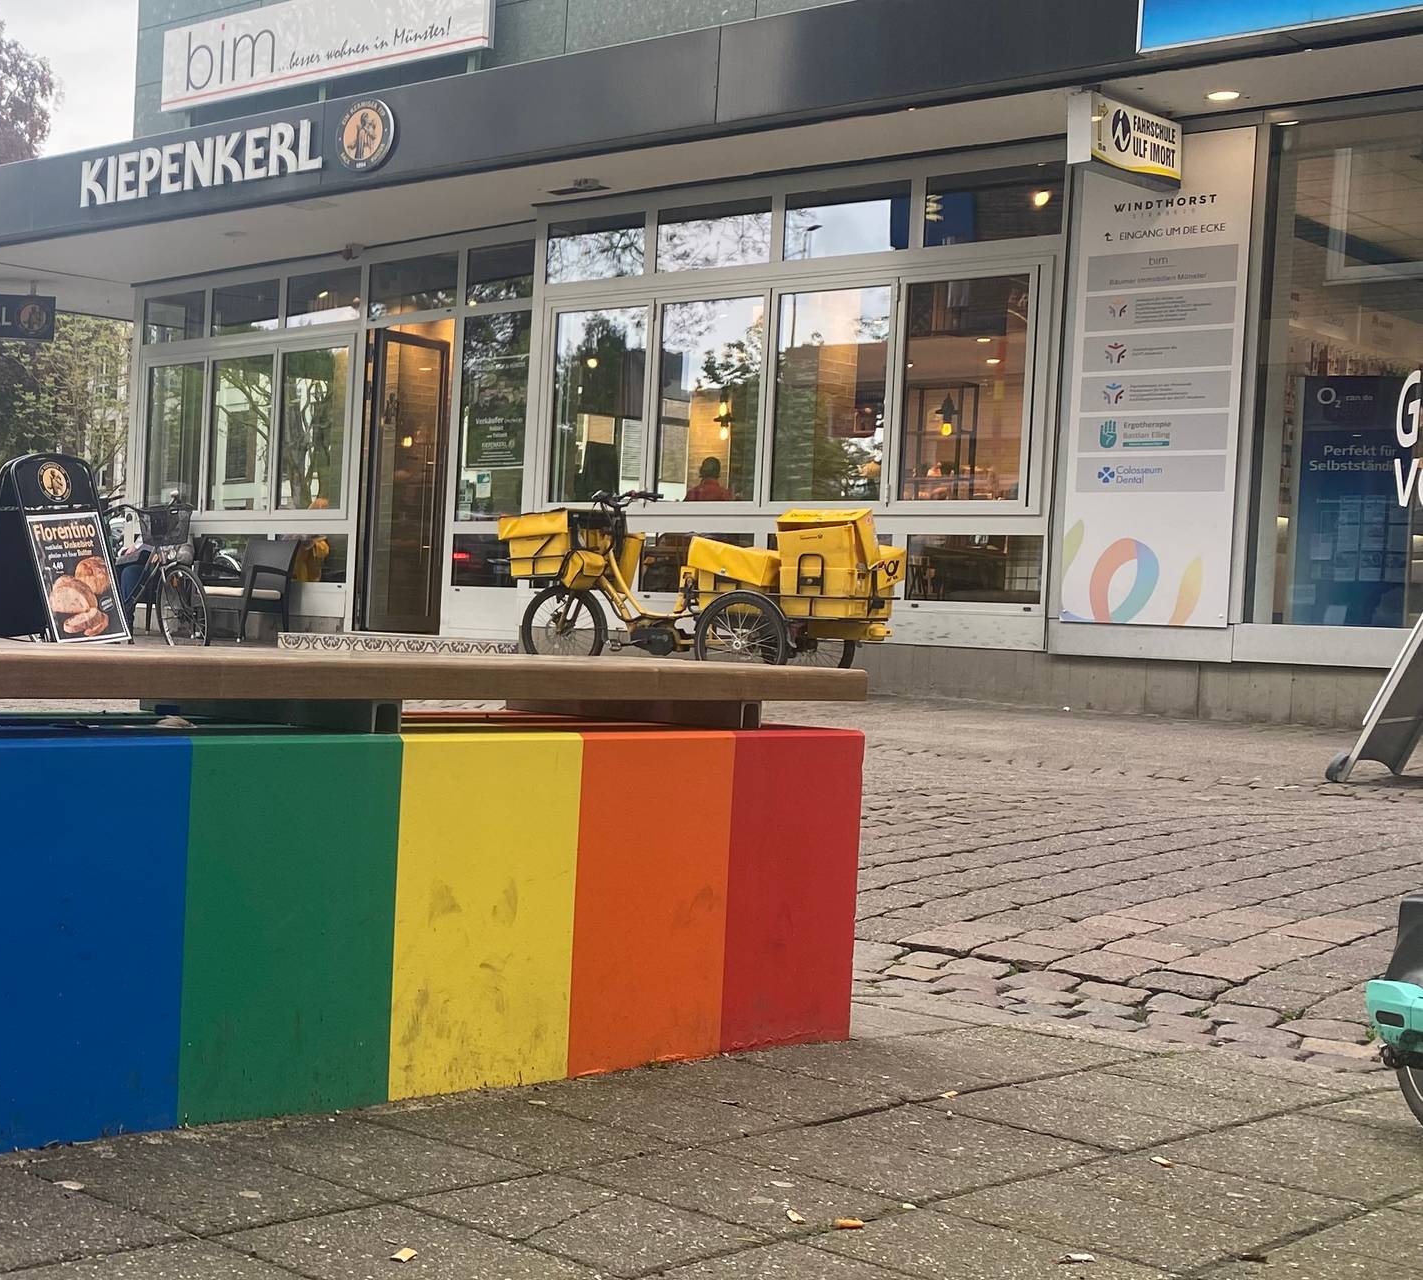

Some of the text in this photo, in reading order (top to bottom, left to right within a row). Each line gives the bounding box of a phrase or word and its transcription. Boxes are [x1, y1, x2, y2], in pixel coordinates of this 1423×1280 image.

[185, 24, 275, 91] bim
[327, 40, 370, 61] wohnen
[373, 35, 388, 51] in
[393, 16, 452, 46] Münster!
[1133, 115, 1176, 145] FAHRSCHULE
[1132, 136, 1176, 169] ULF IMORT
[79, 118, 323, 208] KIEPENKERL
[1114, 194, 1217, 213] WINDTHORST
[1119, 222, 1226, 241] EINGANG UM DIE ECKE
[1123, 421, 1172, 430] Ergotherapie
[1323, 444, 1397, 457] Perfekt für
[1115, 465, 1163, 475] Colosseum
[1309, 460, 1403, 472] Selbstständi
[1115, 475, 1145, 485] Dental
[32, 521, 96, 542] Florentino
